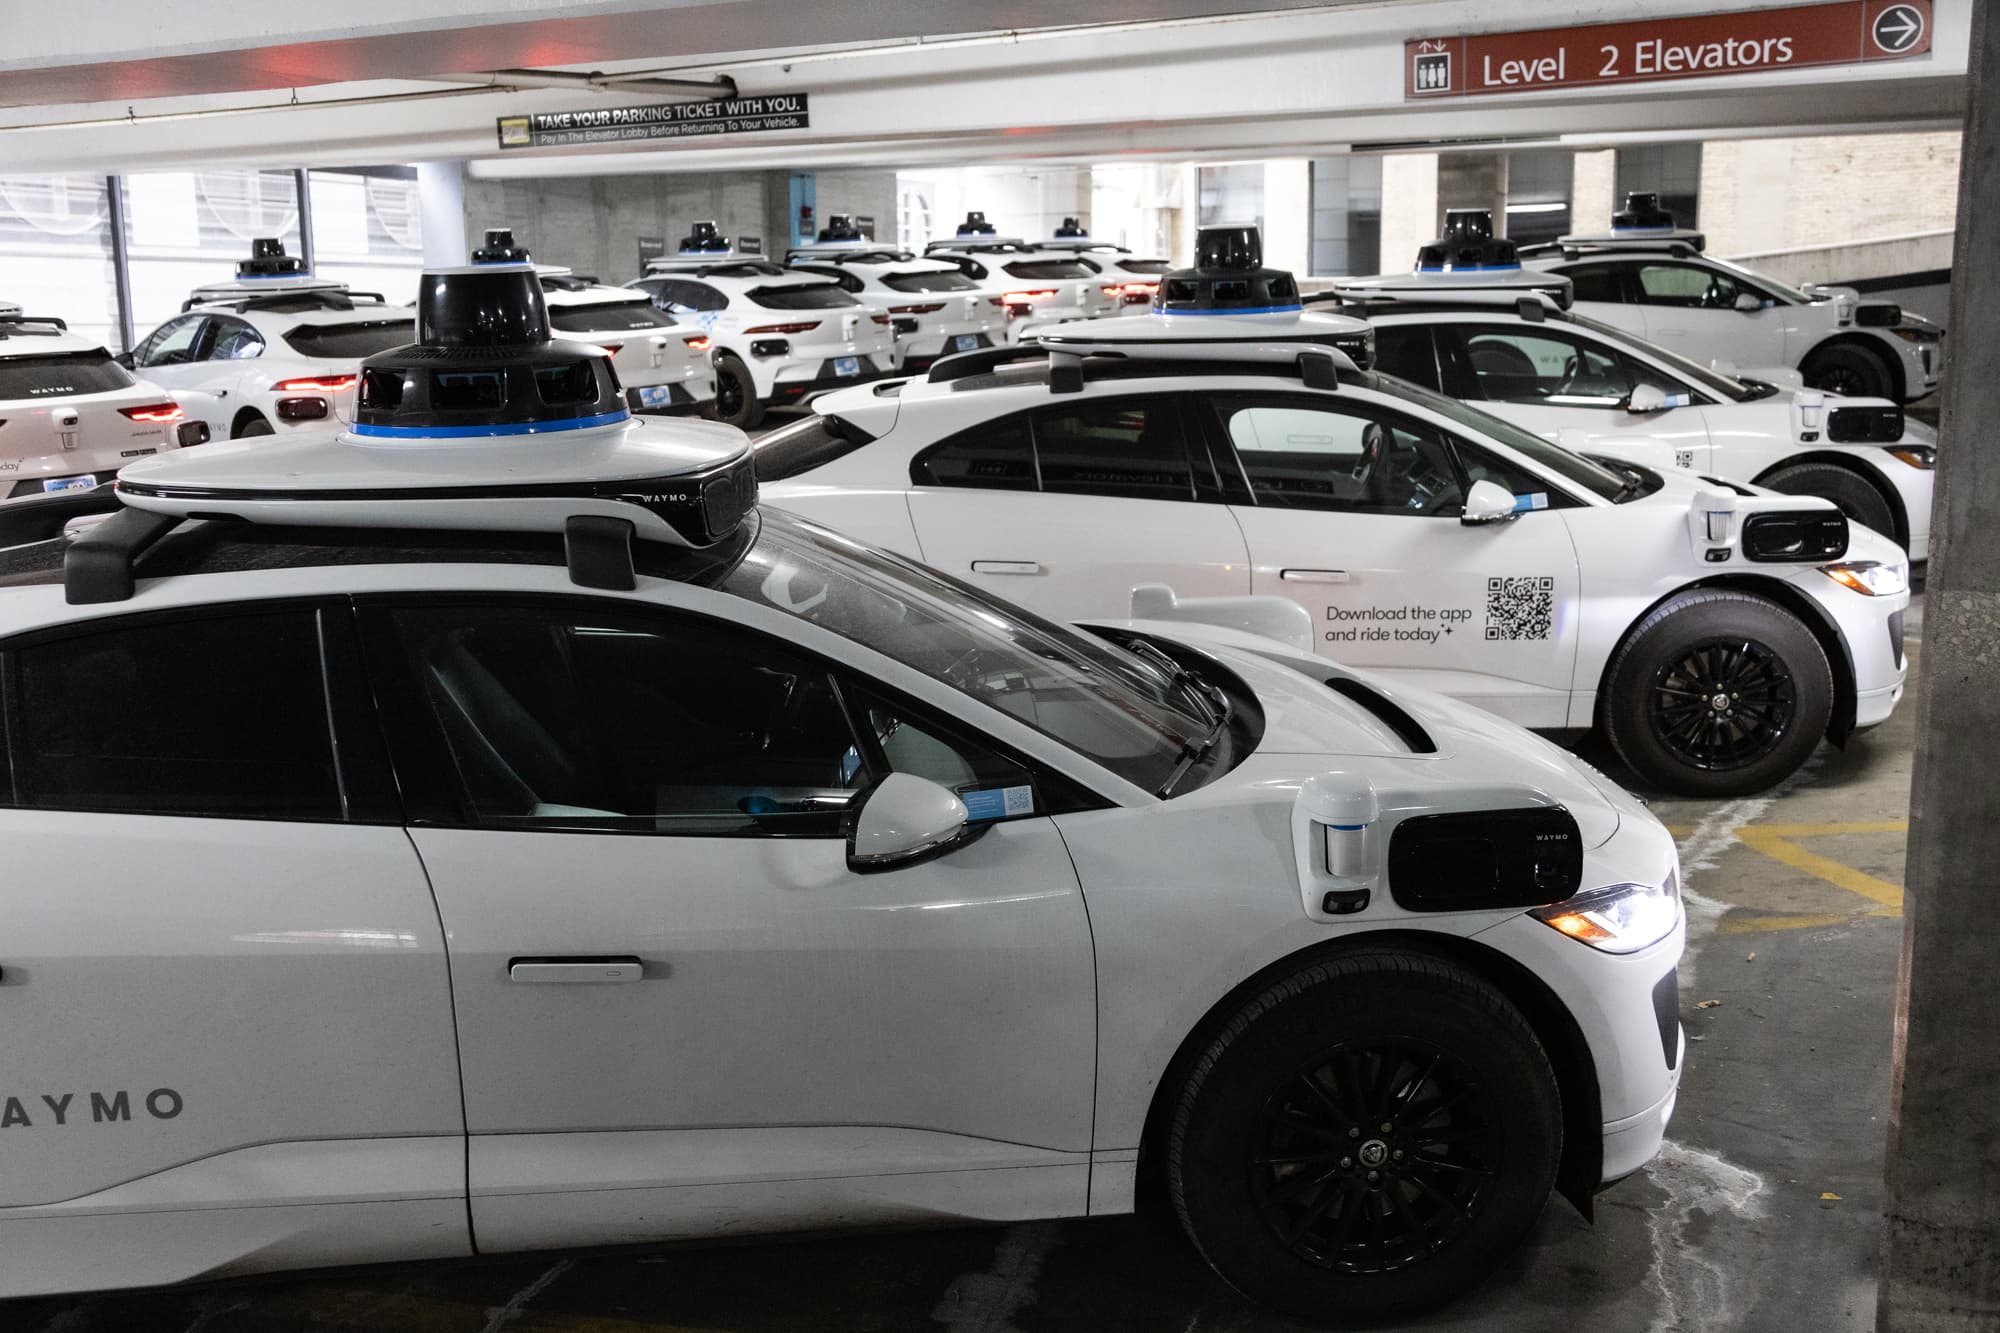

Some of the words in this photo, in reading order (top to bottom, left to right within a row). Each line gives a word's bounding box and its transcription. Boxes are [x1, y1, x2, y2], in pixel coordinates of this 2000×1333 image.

[1483, 48, 1565, 86] Level
[1599, 46, 1619, 76] 2
[1635, 37, 1793, 74] Elevators
[538, 113, 571, 129] TAKE
[572, 110, 610, 126] YOUR
[612, 106, 672, 124] PARKING
[675, 102, 722, 119] TICKET
[725, 100, 762, 115] WITH
[766, 97, 800, 112] YOU.
[541, 133, 556, 145] Pay
[557, 132, 564, 142] In
[567, 131, 584, 142] The
[585, 129, 619, 141] Elevator
[621, 127, 648, 139] Lobby
[651, 125, 680, 136] Before
[682, 122, 725, 134] Returning
[727, 120, 738, 130] To
[740, 119, 761, 129] Your
[763, 116, 800, 128] Vehicle.
[0, 459, 19, 471] day
[643, 494, 686, 502] WAYMO
[1327, 606, 1407, 621] Download
[1411, 606, 1436, 620] the
[1440, 608, 1472, 624] app
[1325, 627, 1356, 642] and
[1360, 627, 1390, 641] ride
[1393, 627, 1440, 644] today
[1, 1088, 183, 1128] AYMO
